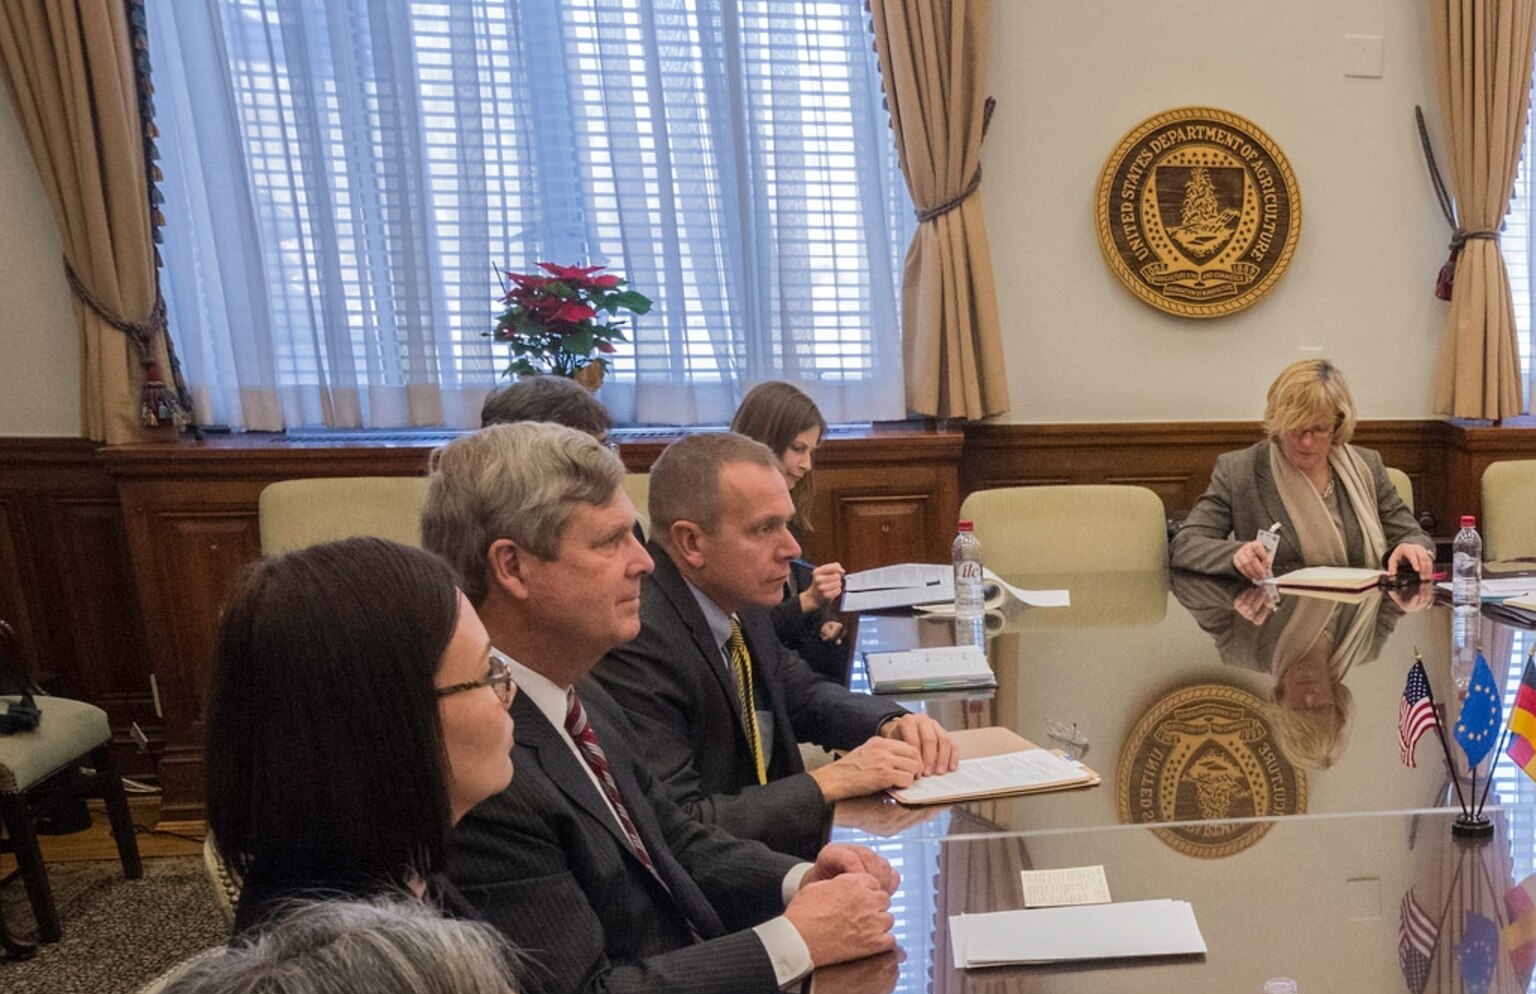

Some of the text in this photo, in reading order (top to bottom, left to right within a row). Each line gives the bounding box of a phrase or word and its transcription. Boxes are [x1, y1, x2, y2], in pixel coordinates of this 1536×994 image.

[1120, 126, 1278, 262] UNITED STATES DEPARTMENT OF AGRICULTURE
[962, 563, 979, 578] ilc
